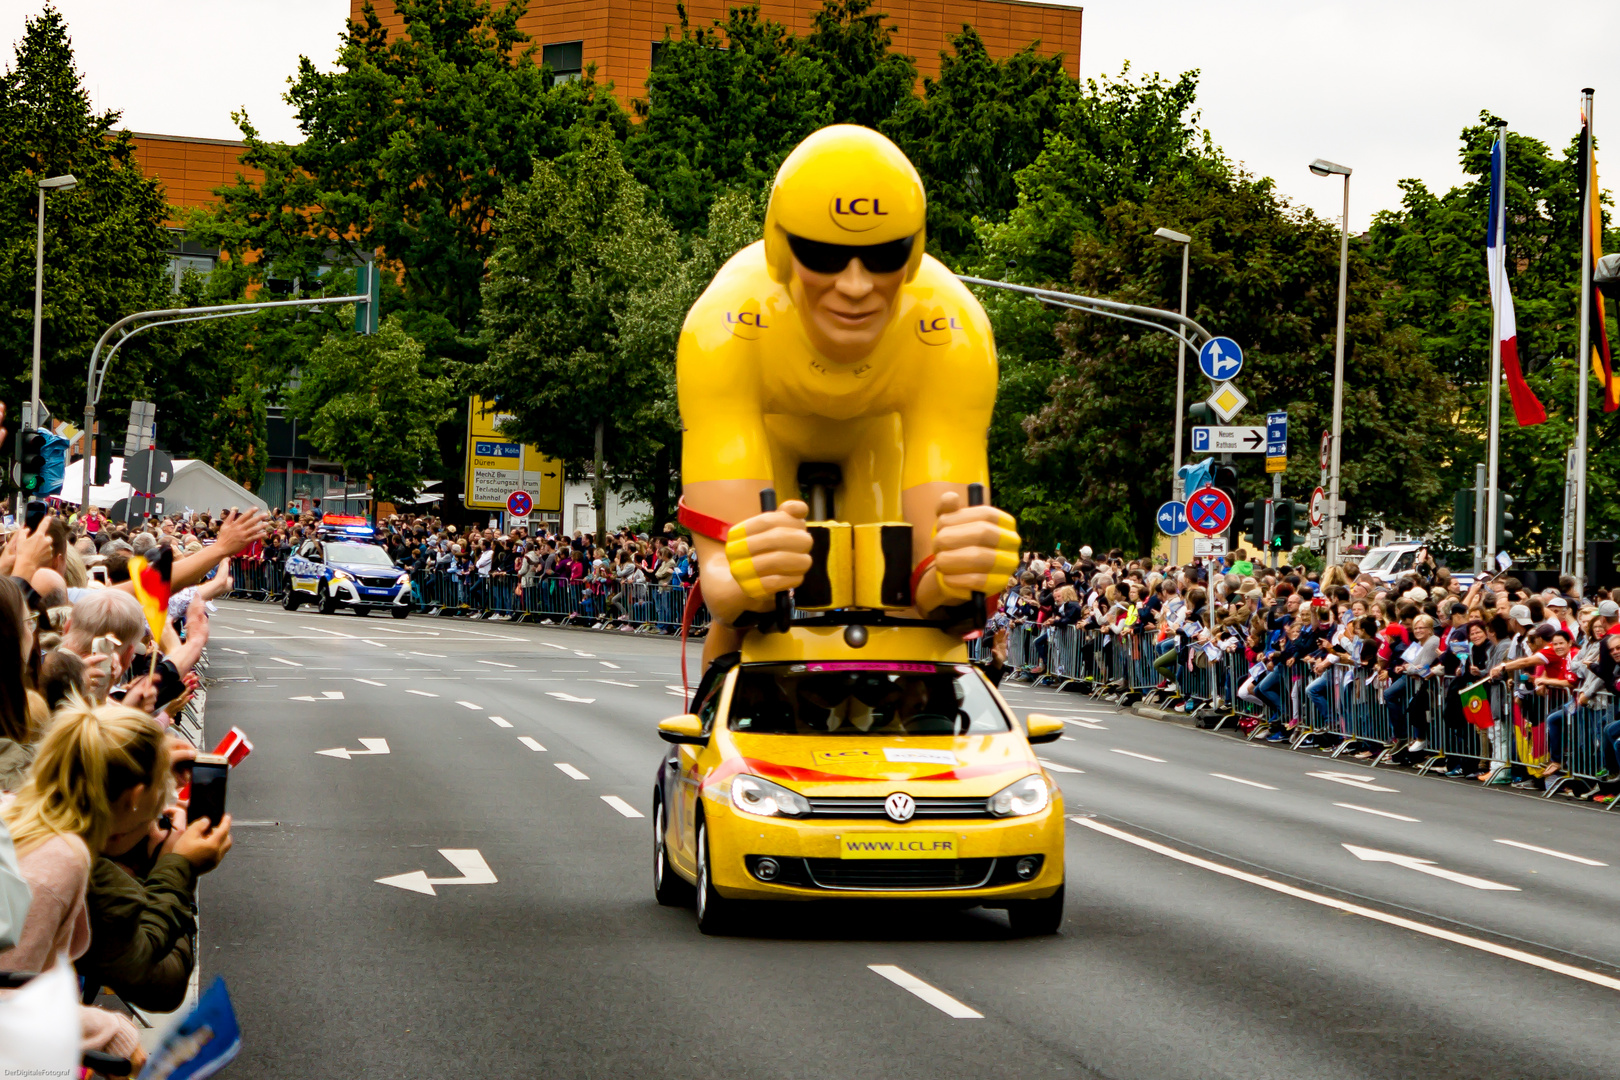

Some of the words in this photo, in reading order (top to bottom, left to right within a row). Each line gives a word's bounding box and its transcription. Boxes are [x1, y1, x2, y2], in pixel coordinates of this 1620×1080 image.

[835, 197, 889, 216] LCL
[726, 311, 769, 329] LCL
[919, 317, 964, 333] LCL
[1196, 430, 1208, 448] P
[845, 840, 954, 852] WWW.LCL.FR
